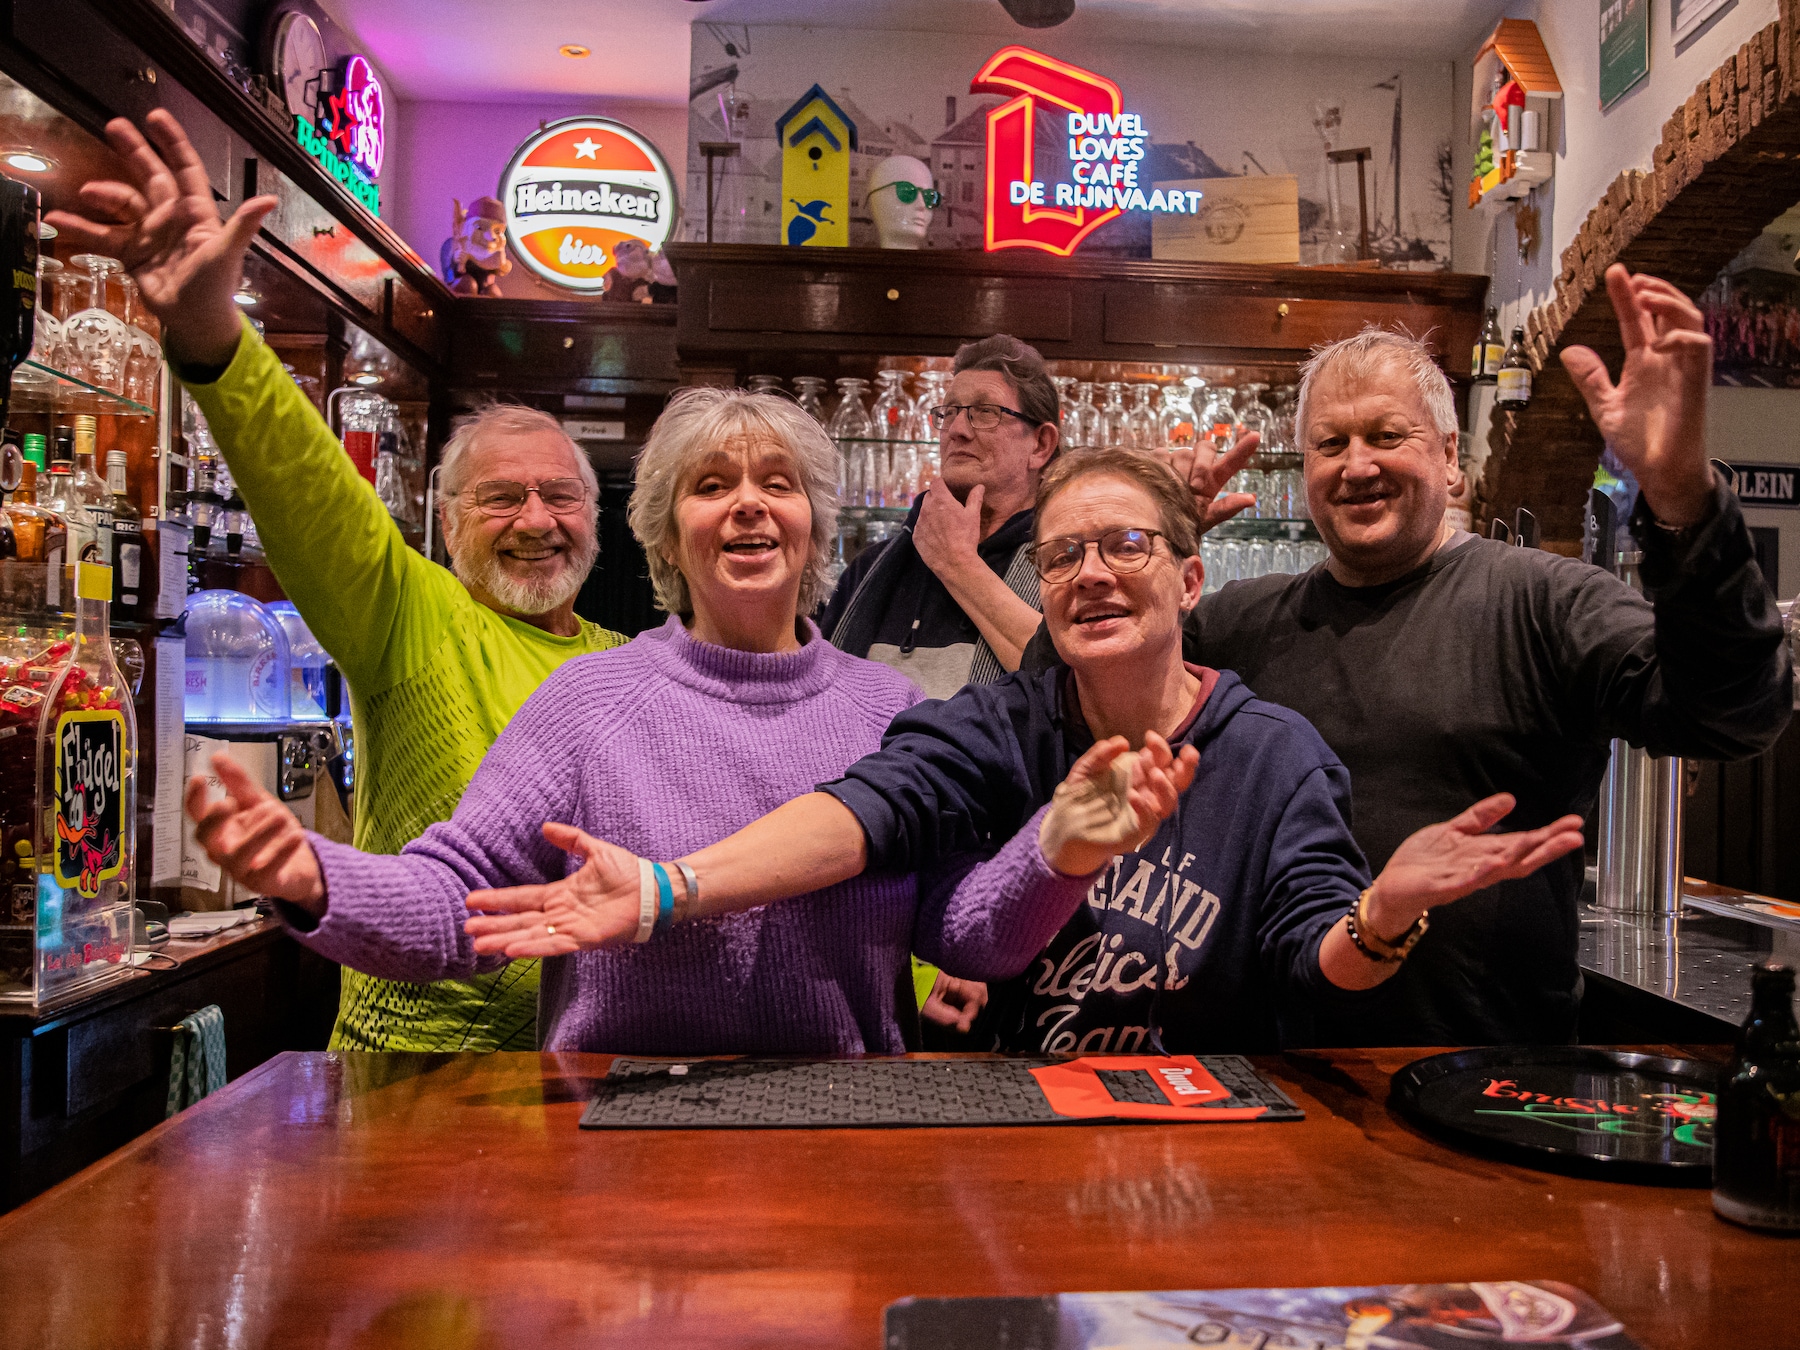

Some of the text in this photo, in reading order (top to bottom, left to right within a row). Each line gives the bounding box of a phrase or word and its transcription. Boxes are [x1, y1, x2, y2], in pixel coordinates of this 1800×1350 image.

[1068, 113, 1148, 136] DUVEL
[1069, 137, 1144, 161] LOVES
[297, 114, 380, 217] Heineken
[1073, 160, 1138, 187] CAFÉ
[516, 181, 657, 219] Heineken
[1010, 181, 1045, 204] DE
[1056, 183, 1202, 214] RIJNVAART
[559, 233, 607, 265] bier
[1739, 471, 1794, 499] LEIN
[185, 677, 207, 687] RESH
[62, 718, 119, 815] Flügel
[1158, 1067, 1212, 1095] Duvel
